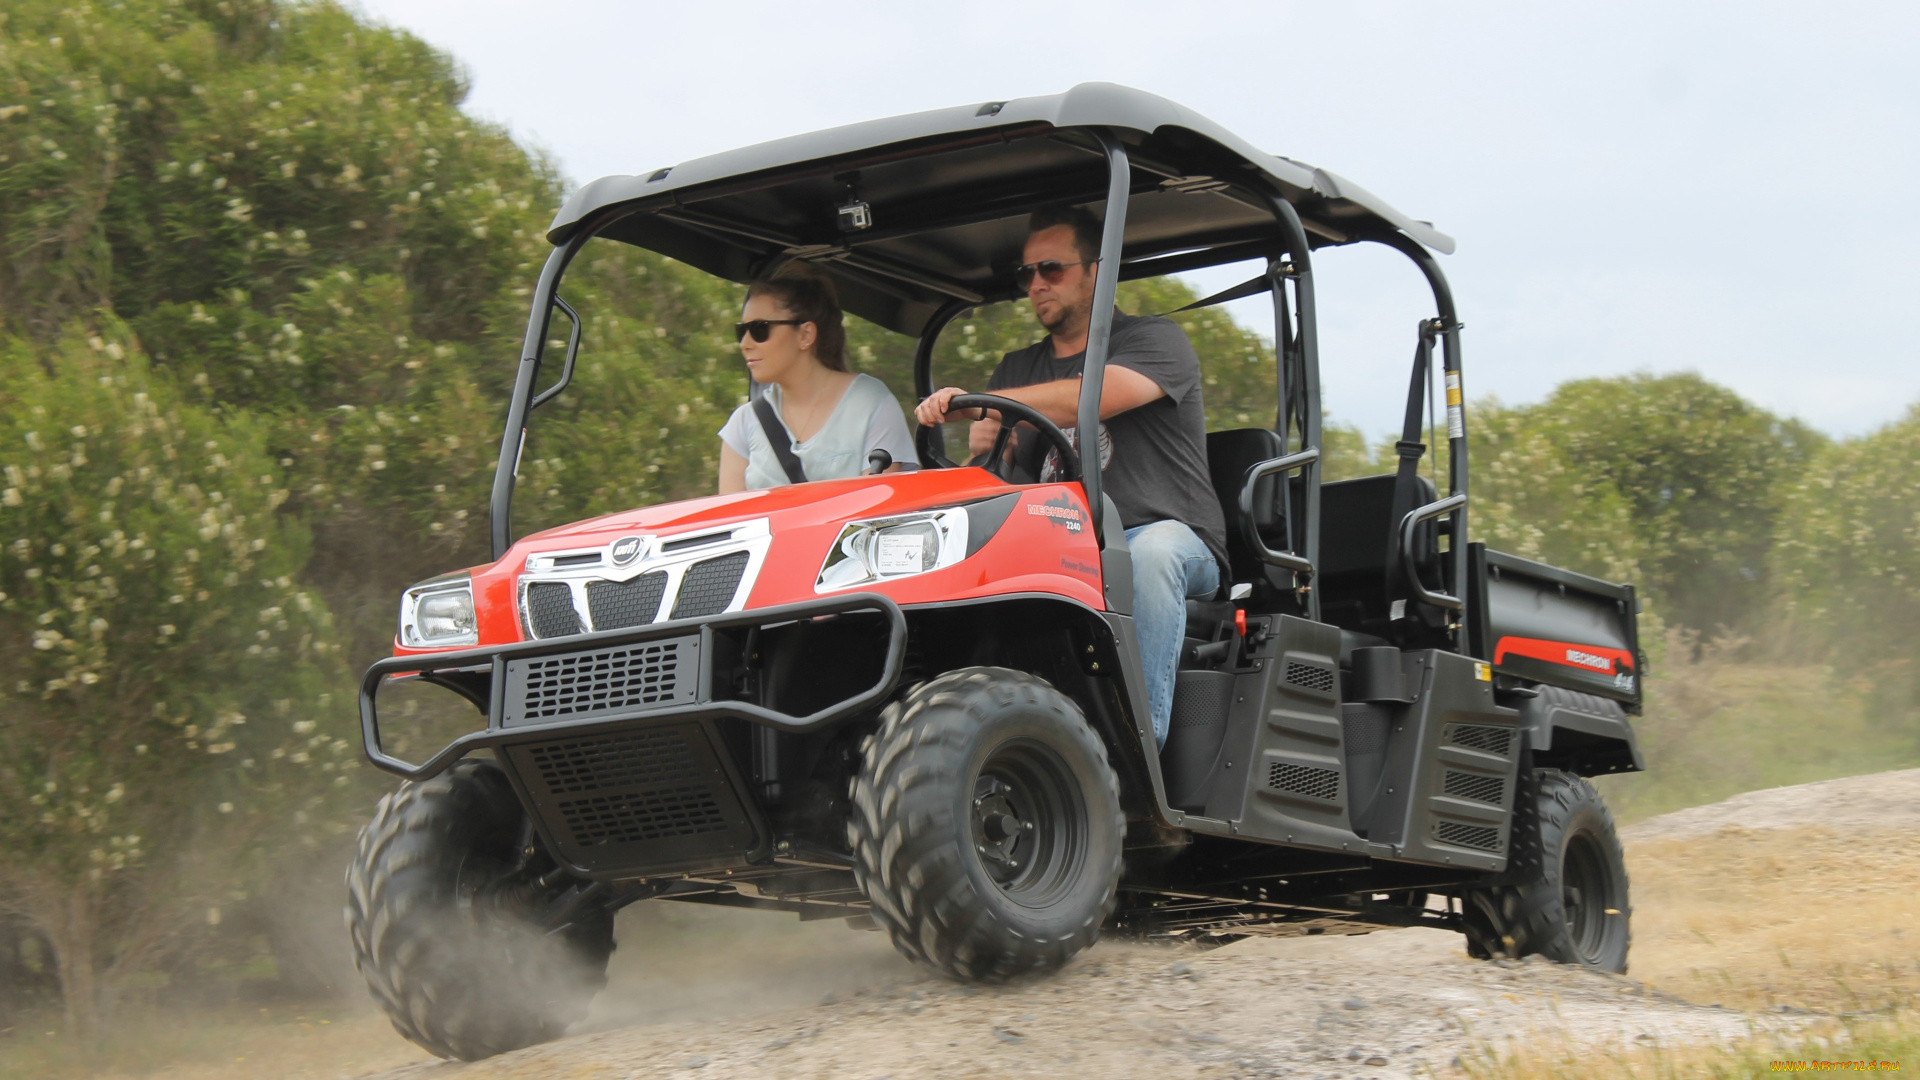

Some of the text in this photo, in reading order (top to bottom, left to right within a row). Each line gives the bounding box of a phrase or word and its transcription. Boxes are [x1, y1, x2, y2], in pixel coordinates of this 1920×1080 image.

[1027, 504, 1079, 520] MECHRON
[1065, 521, 1080, 531] 2240
[1566, 649, 1610, 670] MECHRON
